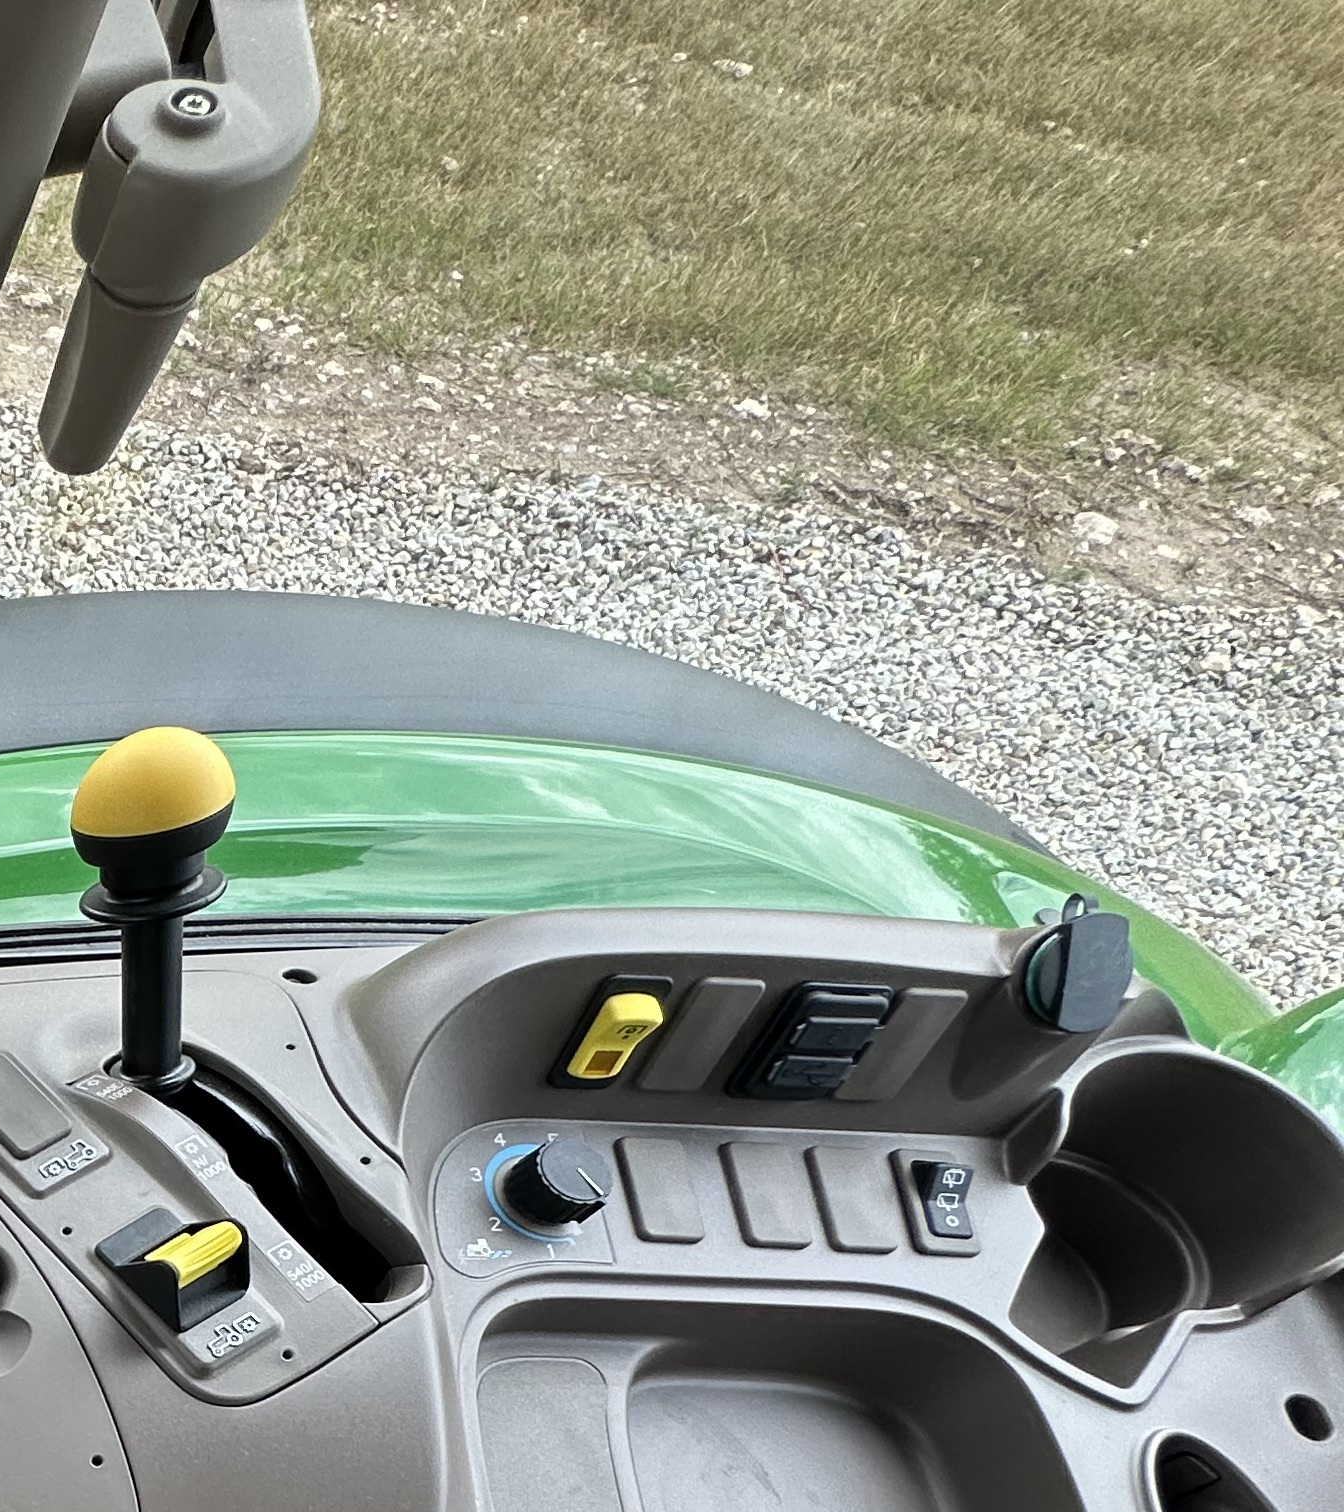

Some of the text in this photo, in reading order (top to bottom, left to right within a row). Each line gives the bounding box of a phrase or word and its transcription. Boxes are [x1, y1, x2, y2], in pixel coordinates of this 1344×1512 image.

[494, 1132, 507, 1147] 4
[192, 1153, 209, 1169] N/
[198, 1161, 227, 1181] 1000
[469, 1167, 483, 1182] 3
[488, 1216, 503, 1232] 2
[547, 1243, 555, 1259] 1
[286, 1259, 313, 1281] 540/
[295, 1269, 325, 1291] 1000
